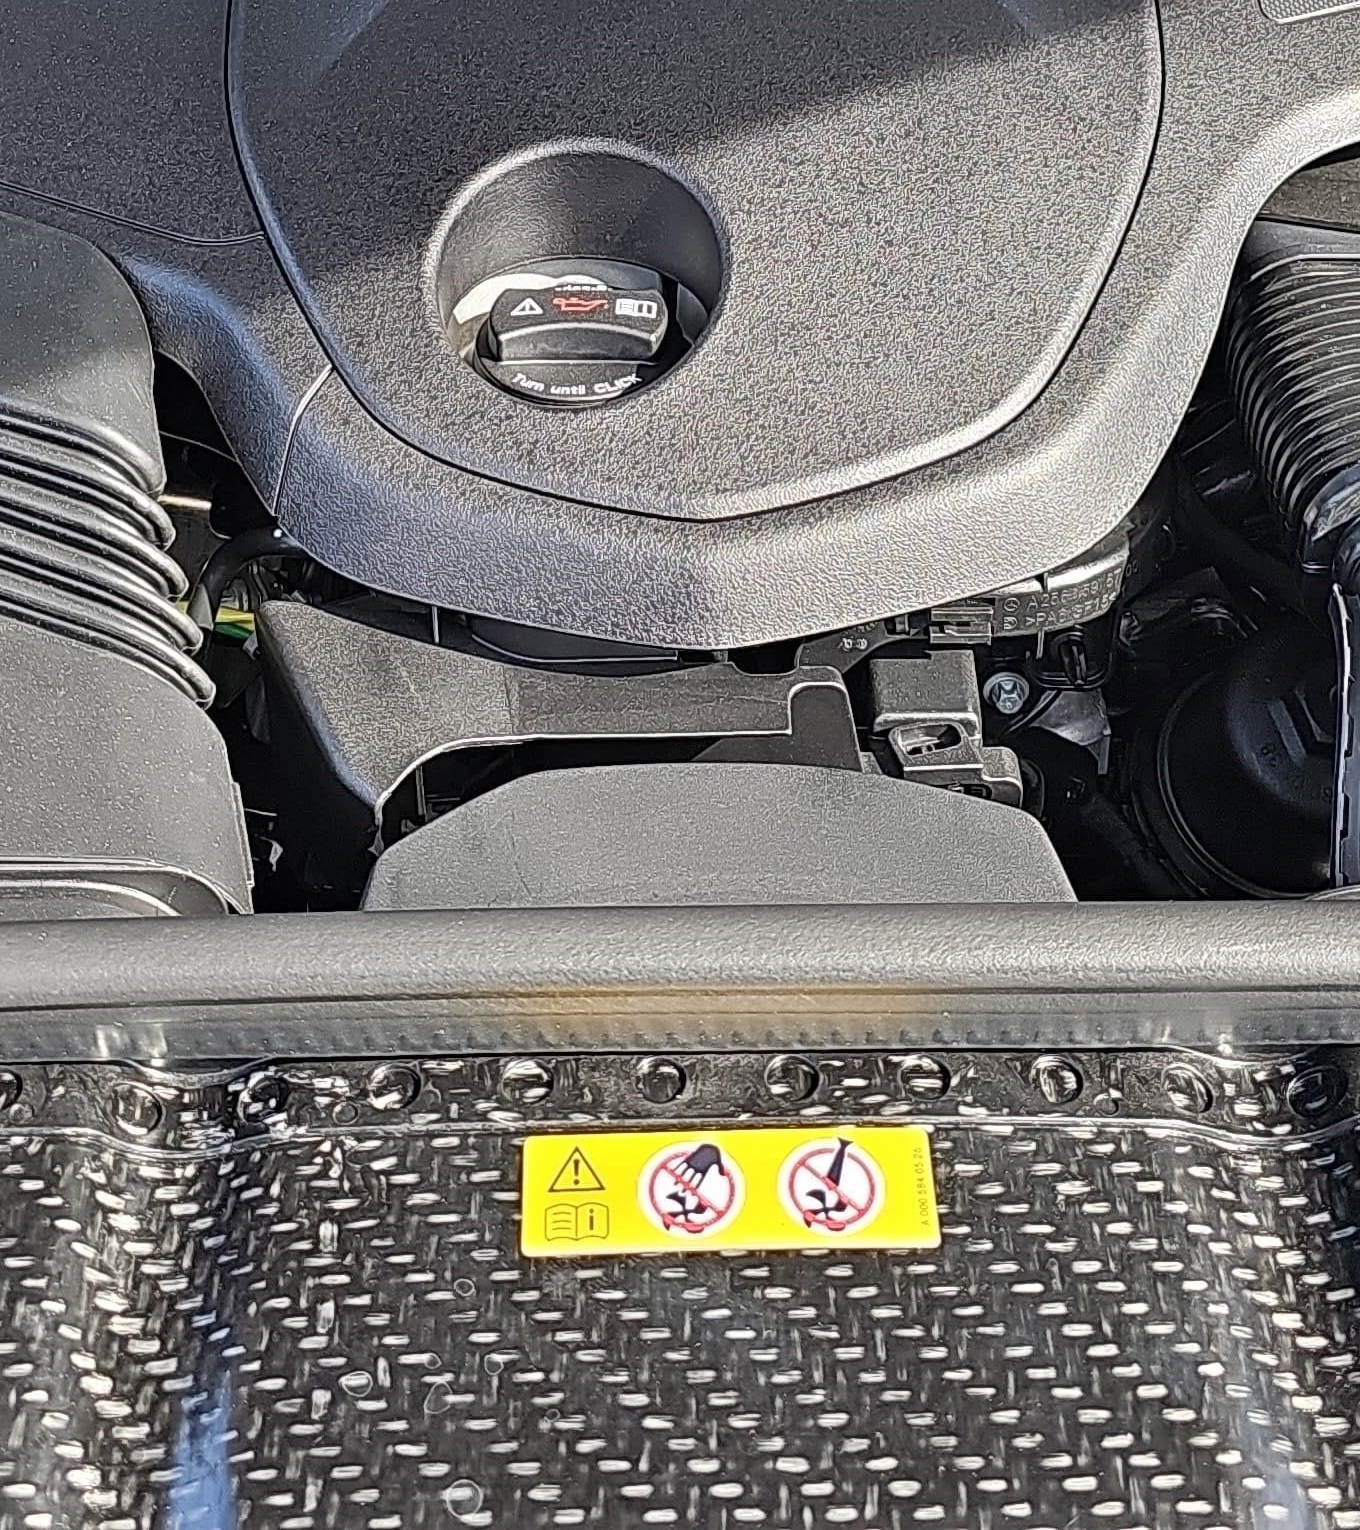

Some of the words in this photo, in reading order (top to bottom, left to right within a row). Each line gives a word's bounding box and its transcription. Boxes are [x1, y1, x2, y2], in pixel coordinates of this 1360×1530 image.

[511, 372, 545, 392] Turn
[550, 383, 586, 395] until
[593, 372, 643, 394] CLICK
[918, 1198, 929, 1217] 000
